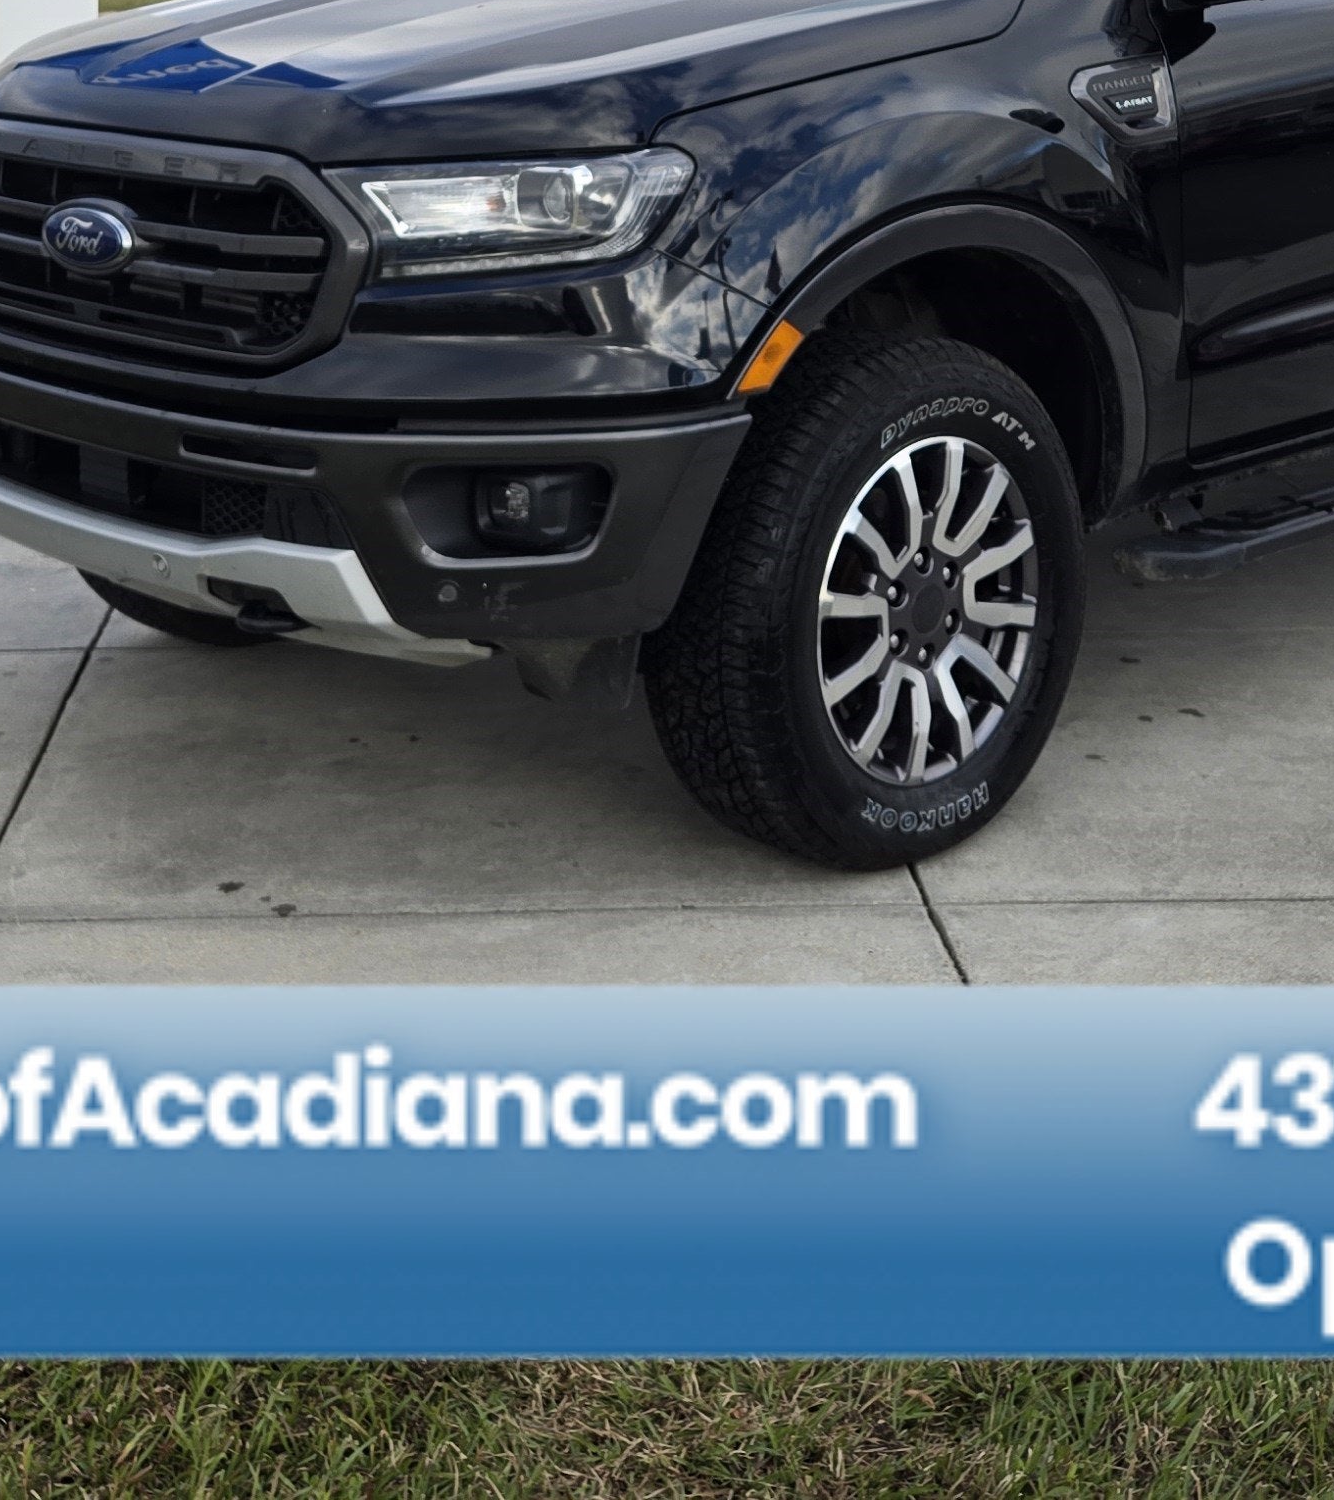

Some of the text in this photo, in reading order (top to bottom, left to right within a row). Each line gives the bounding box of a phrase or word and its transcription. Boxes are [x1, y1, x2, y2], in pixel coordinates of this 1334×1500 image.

[1092, 74, 1152, 92] RANGER
[54, 215, 104, 256] Ford
[880, 396, 990, 449] Dynapro
